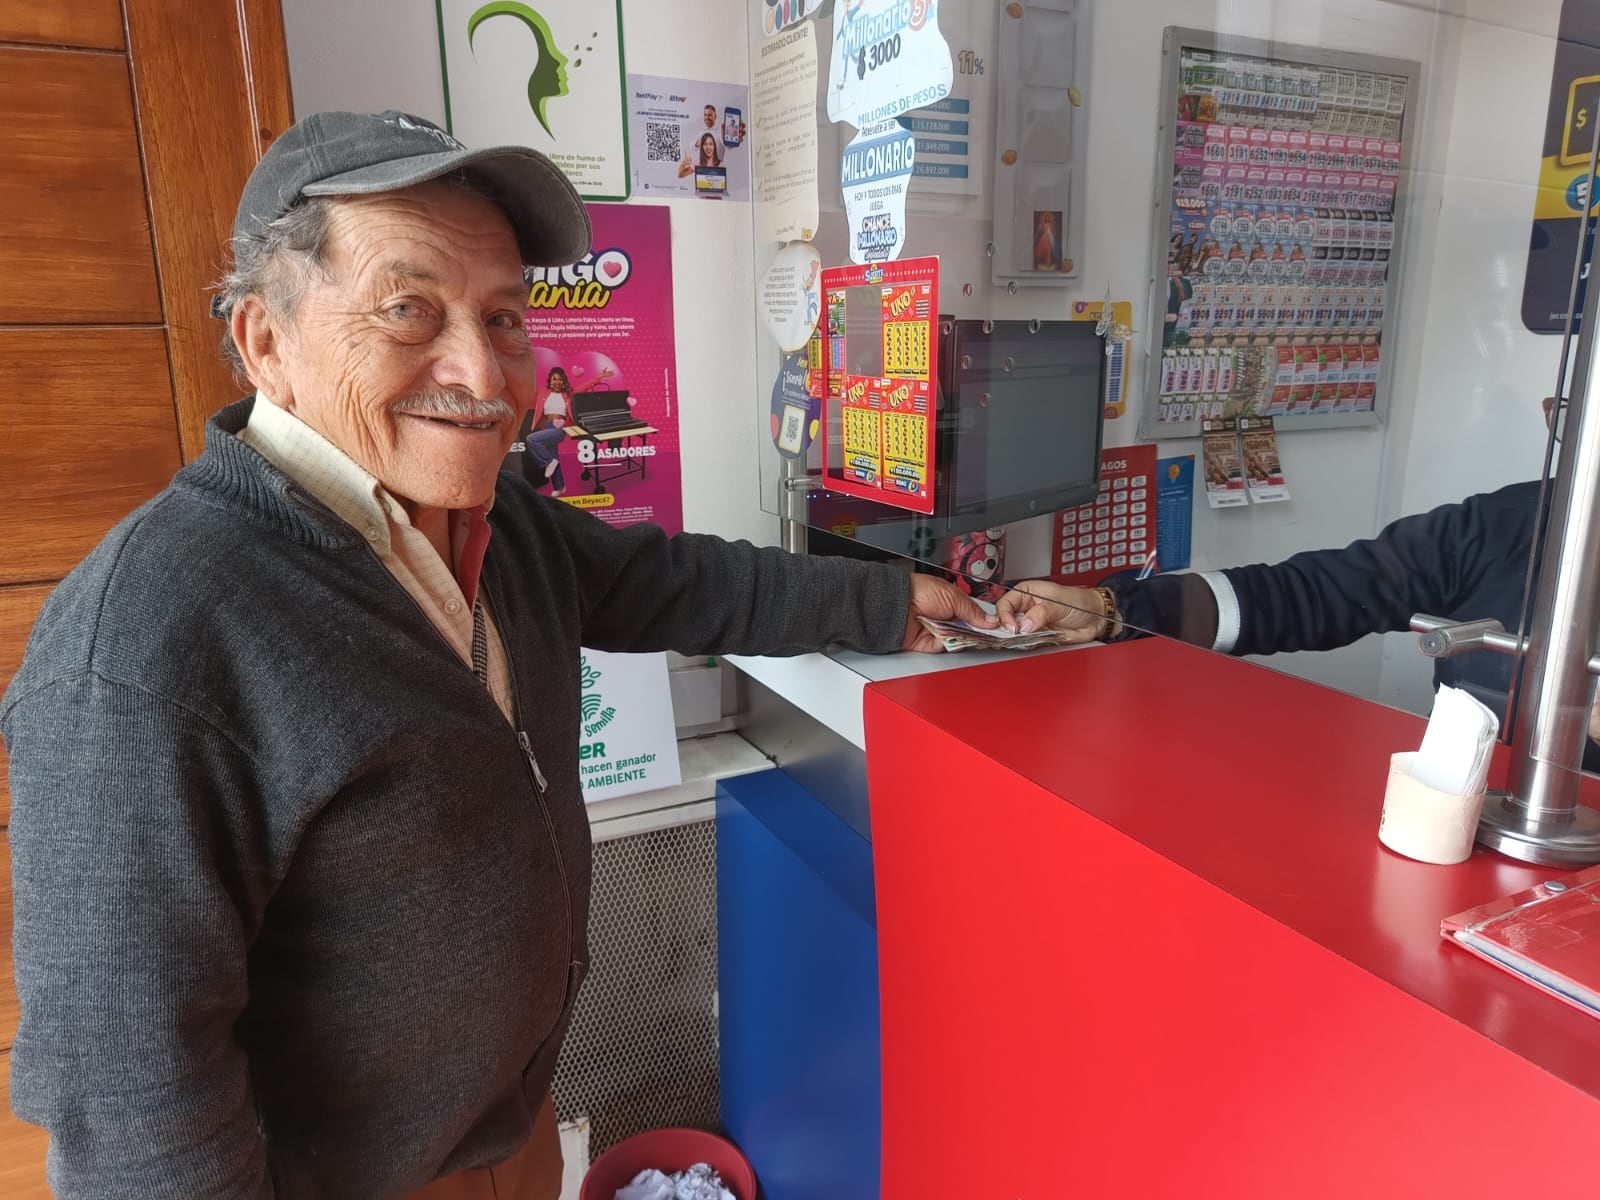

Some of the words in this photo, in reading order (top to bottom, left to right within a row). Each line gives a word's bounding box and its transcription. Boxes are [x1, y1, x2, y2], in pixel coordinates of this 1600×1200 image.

[868, 33, 902, 71] 3000
[858, 105, 898, 127] MILLONES
[900, 95, 912, 111] DE
[913, 83, 949, 105] PESOS
[1575, 107, 1588, 130] $
[842, 137, 915, 182] MILLONARIO
[1205, 144, 1225, 155] 1660
[1229, 145, 1249, 157] 3191
[889, 291, 911, 319] UNO
[848, 381, 865, 403] UNO
[888, 385, 909, 409] UNO
[577, 439, 596, 464] 8
[597, 444, 656, 459] ASADORES
[1101, 459, 1127, 471] AGOS
[584, 706, 617, 737] Semilla
[581, 762, 613, 775] hacen
[616, 753, 657, 771] ganador
[588, 768, 647, 790] AMBIENTE
